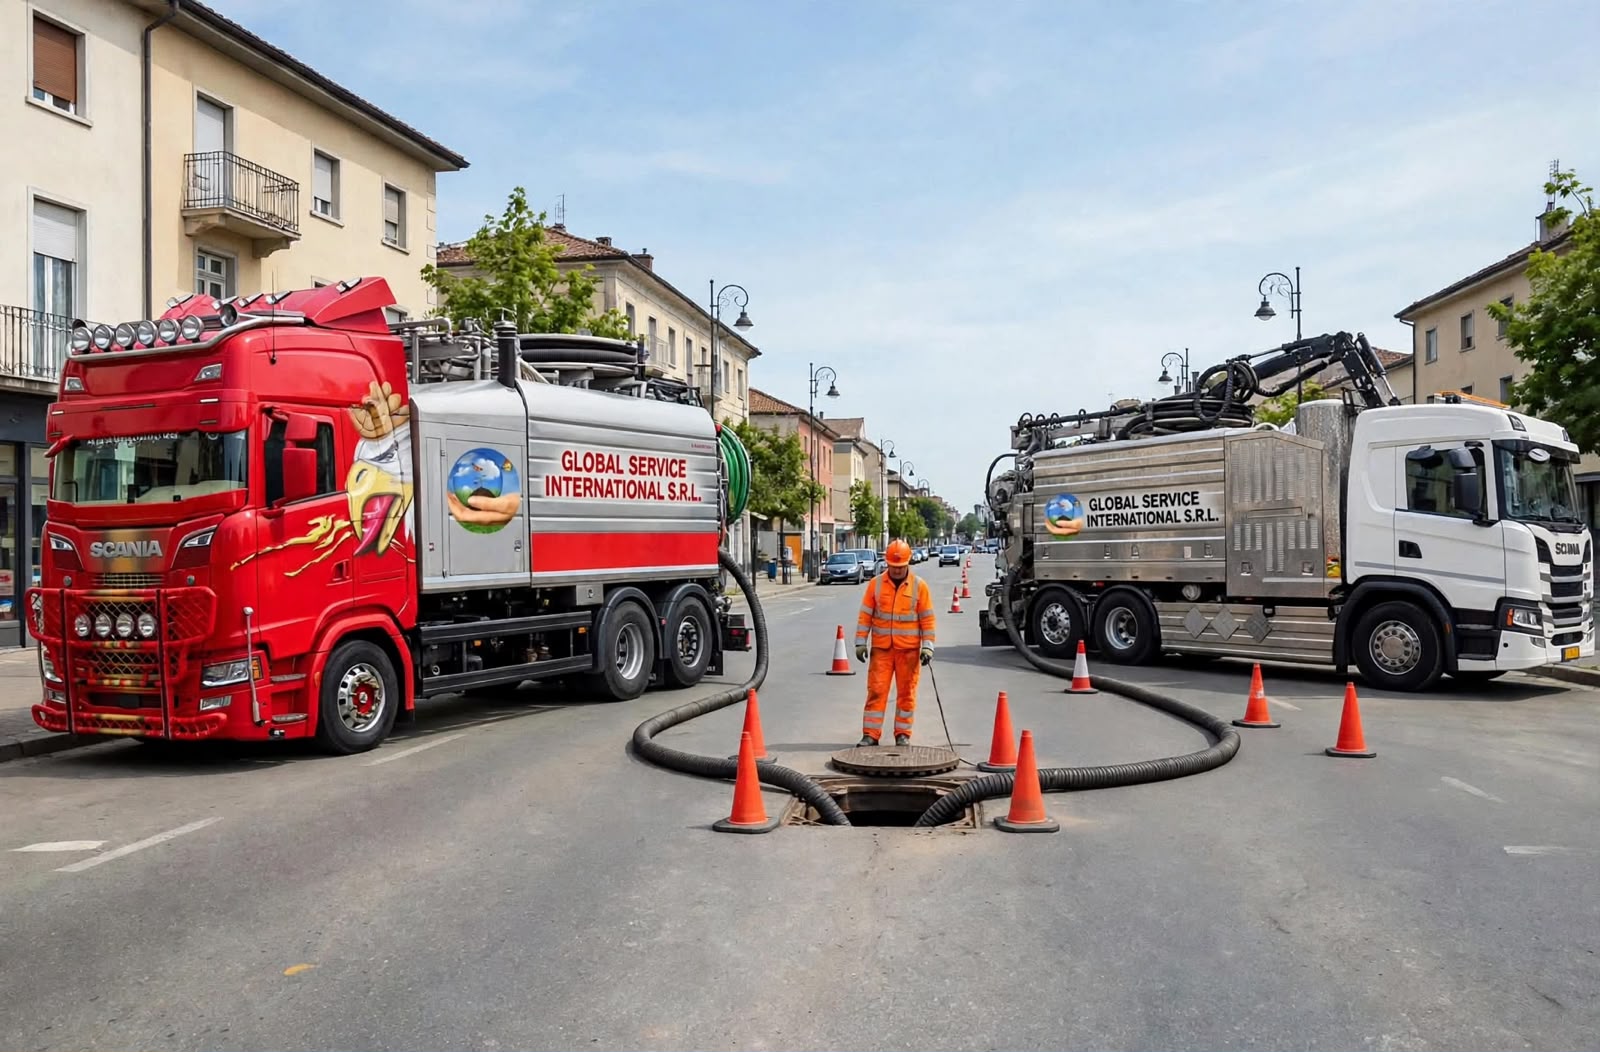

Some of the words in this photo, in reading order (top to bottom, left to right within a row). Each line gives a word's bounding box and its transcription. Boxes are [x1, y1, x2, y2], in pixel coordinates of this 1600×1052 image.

[561, 450, 624, 475] GLOBAL
[628, 455, 687, 478] SERVICE
[545, 475, 665, 500] INTERNATIONAL
[667, 481, 702, 502] S.R.L.
[1088, 495, 1139, 511] GLOBAL
[1141, 491, 1200, 508] SERVICE
[1086, 510, 1181, 528] INTERNATIONAL
[1183, 508, 1219, 523] S.R.L.
[90, 540, 163, 558] SCANIA
